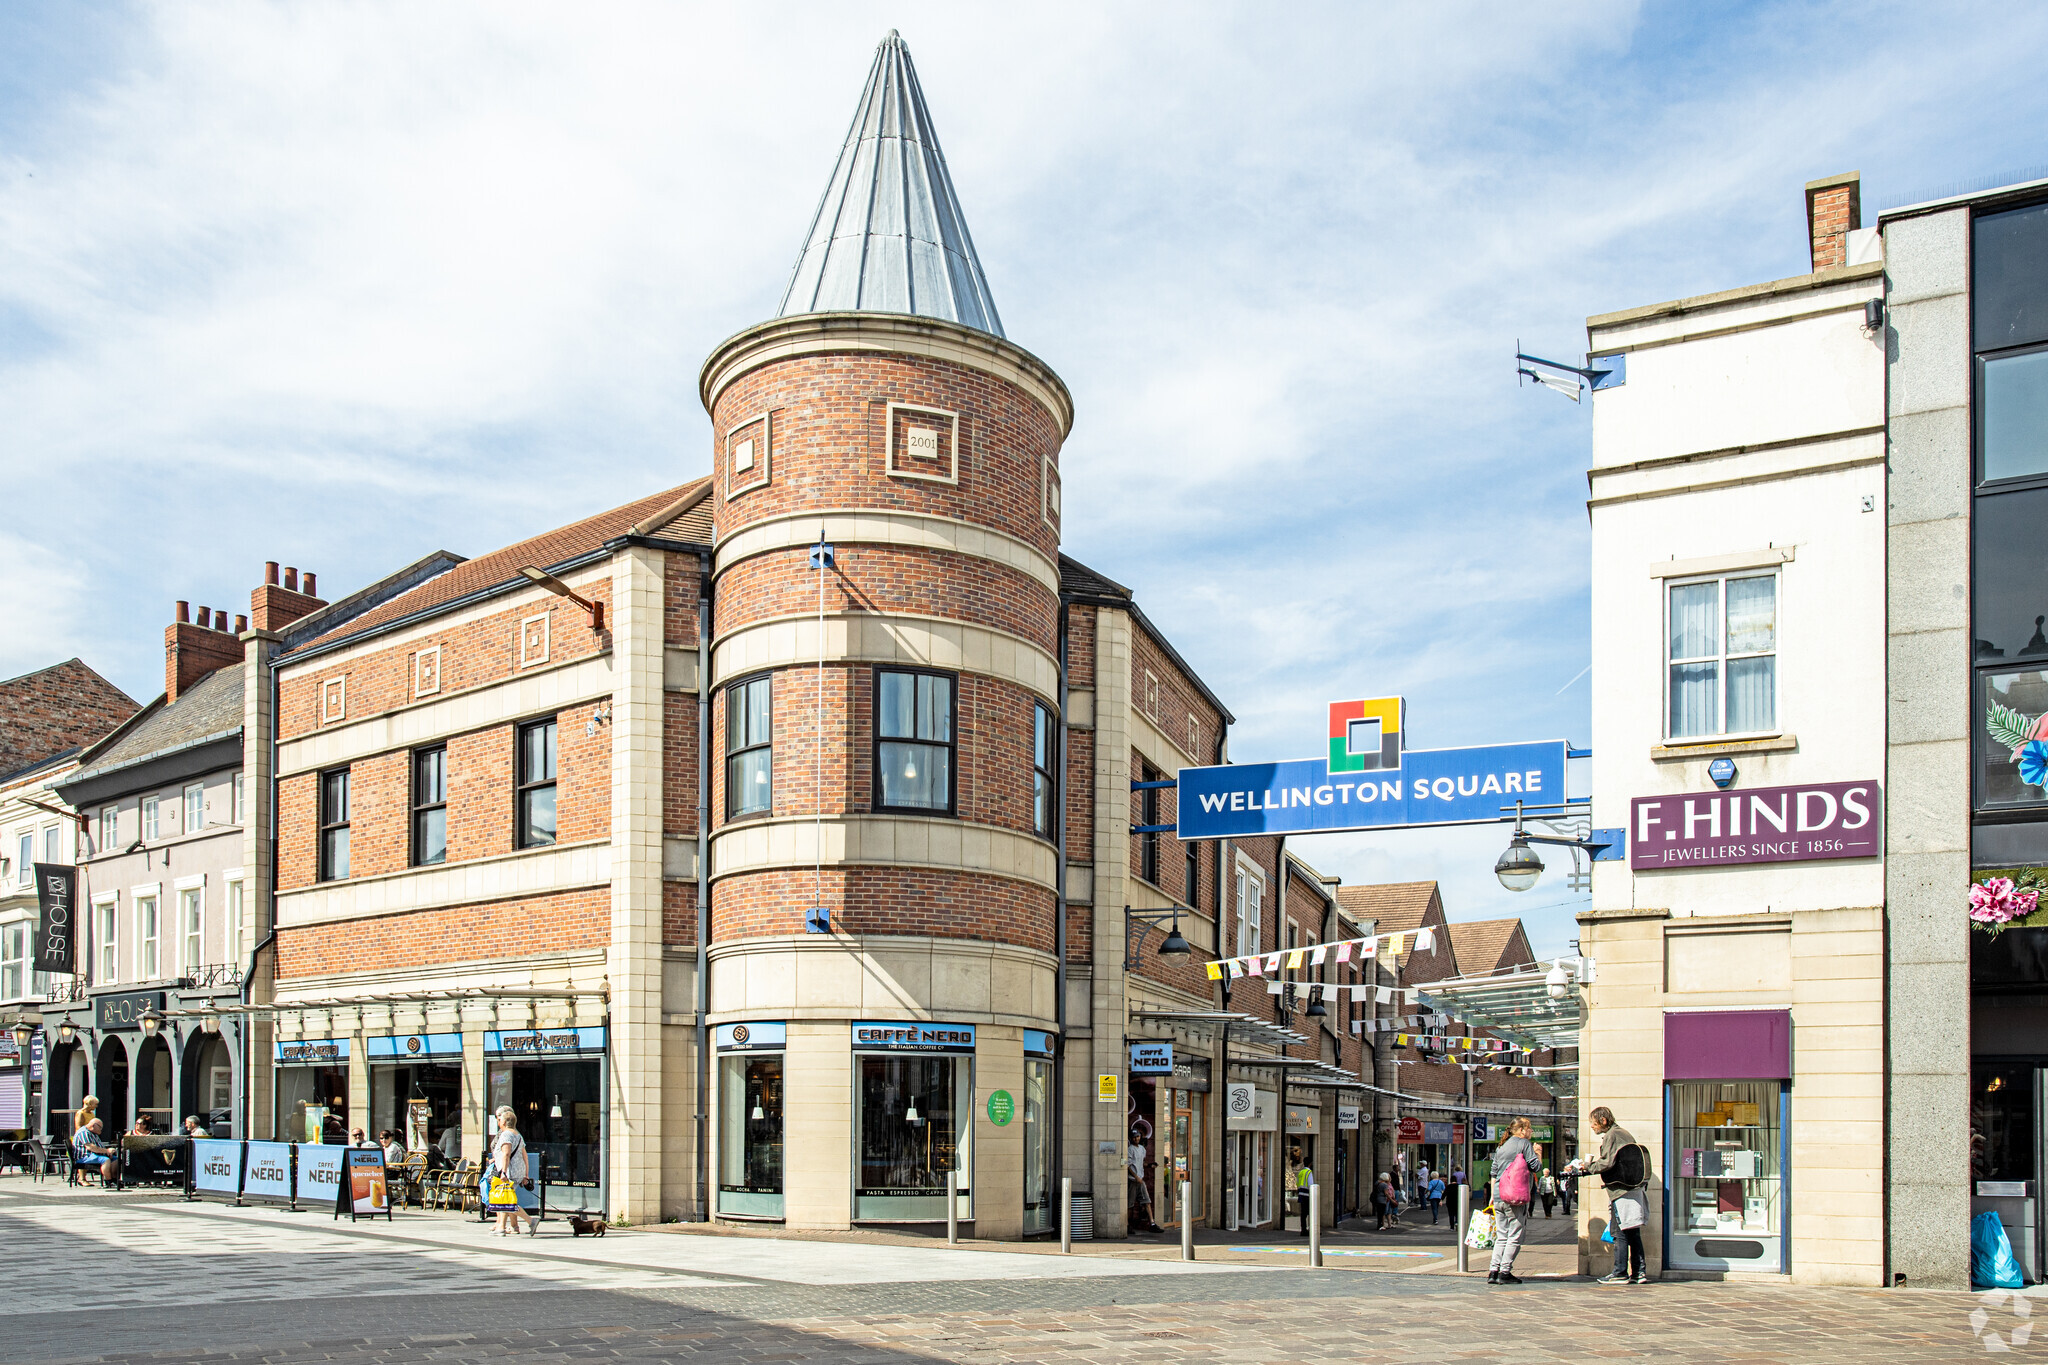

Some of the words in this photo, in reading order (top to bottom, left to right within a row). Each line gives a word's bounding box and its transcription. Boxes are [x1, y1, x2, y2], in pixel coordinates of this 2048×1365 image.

[910, 436, 936, 449] 2001
[1199, 780, 1402, 814] WELLINGTON
[1413, 770, 1542, 802] SQUARE
[1662, 844, 1747, 863] JEWELLERS
[1752, 841, 1799, 856] SINCE
[1806, 838, 1844, 853] 1856
[46, 893, 67, 961] HOUSE
[543, 1034, 580, 1048] NERO
[858, 1025, 919, 1042] CAFFÈ
[920, 1030, 972, 1044] NERO
[312, 1045, 340, 1056] NERO
[1134, 1057, 1168, 1067] NERO
[1339, 1111, 1355, 1119] Hays
[204, 1163, 231, 1177] NERO
[251, 1167, 284, 1182] NERO
[351, 1170, 384, 1179] quencher
